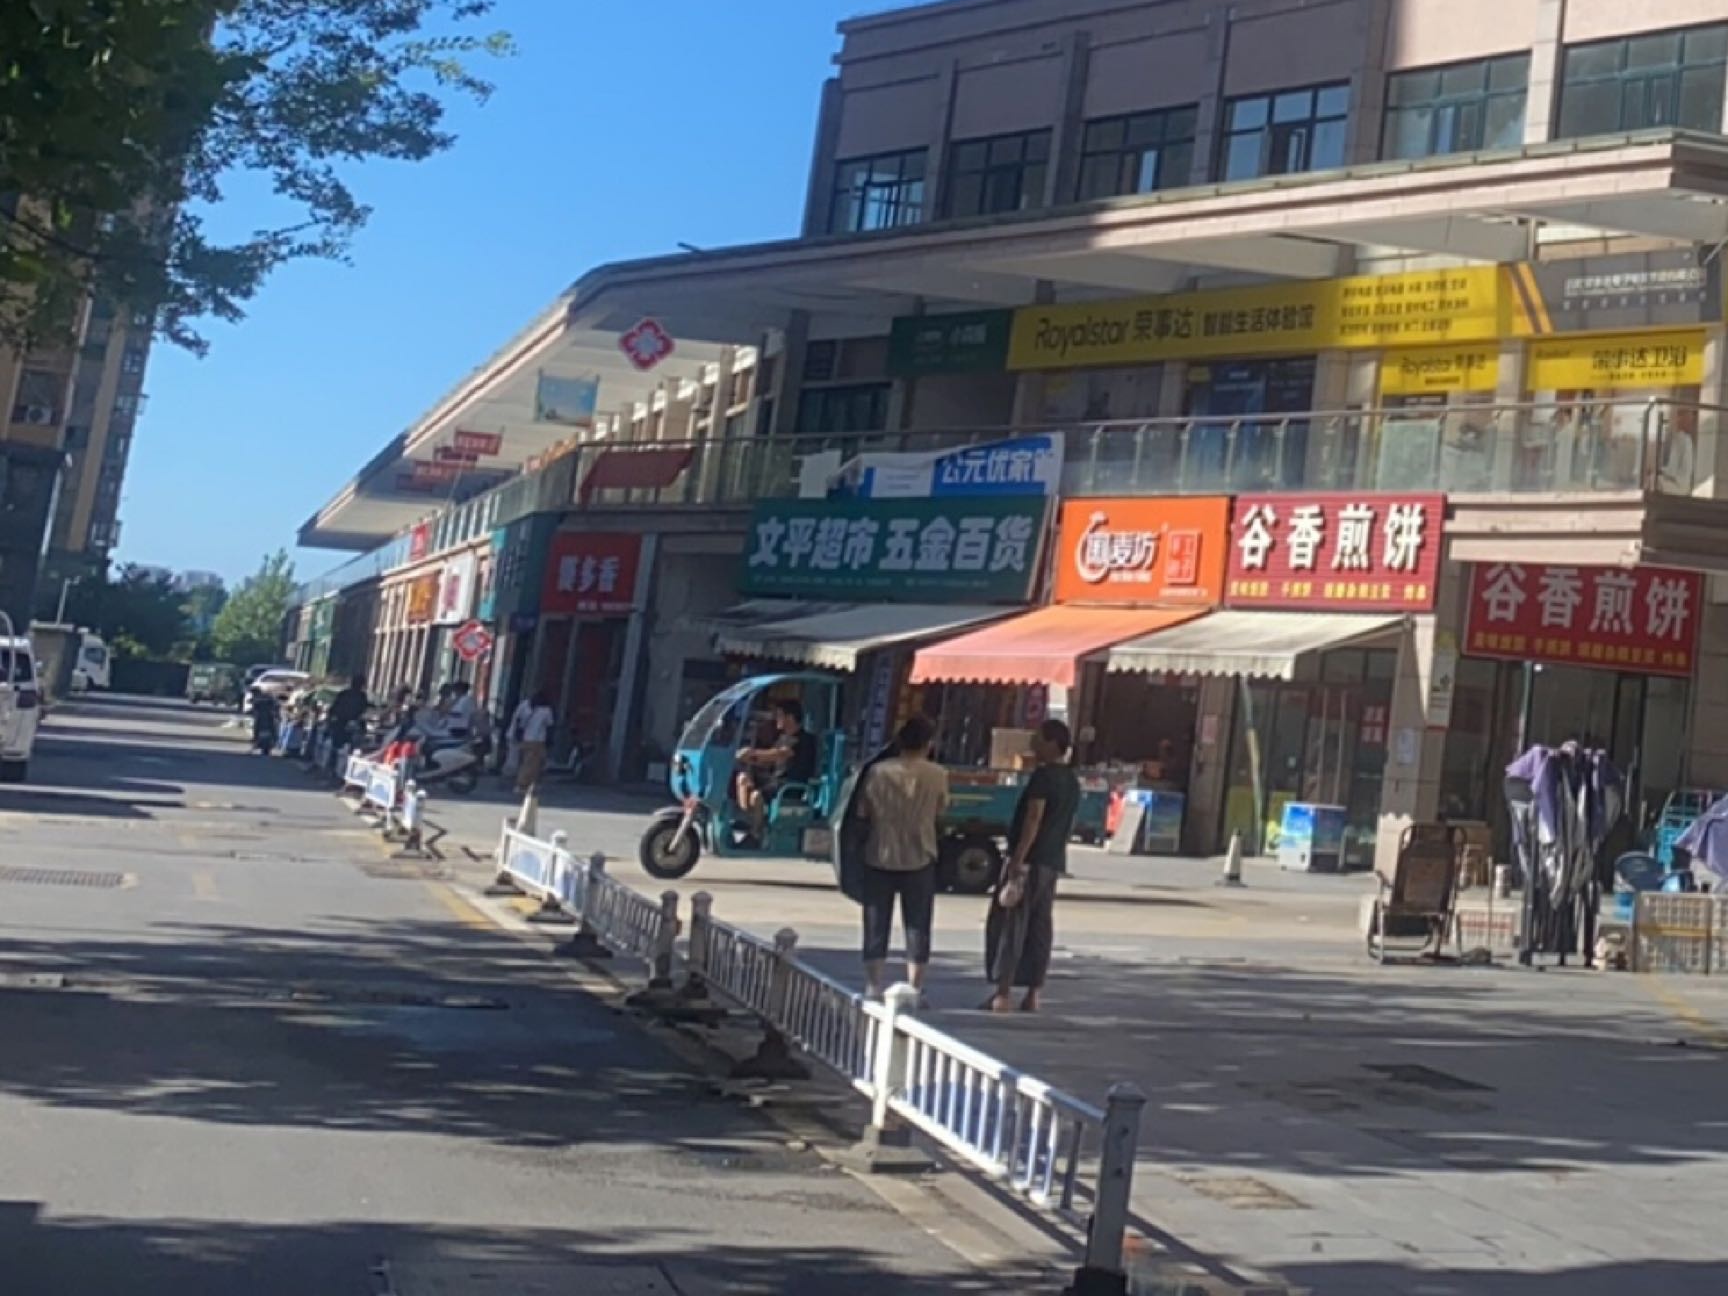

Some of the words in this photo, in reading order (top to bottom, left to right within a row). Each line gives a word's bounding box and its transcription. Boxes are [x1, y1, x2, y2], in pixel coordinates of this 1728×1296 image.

[1035, 315, 1130, 358] Royalstar
[1132, 308, 1195, 342] 荣事达
[748, 515, 881, 570] 文平超市
[878, 514, 1035, 573] 五金百货
[1237, 502, 1427, 572] 谷香煎饼
[1480, 562, 1691, 642] 谷香煎饼
